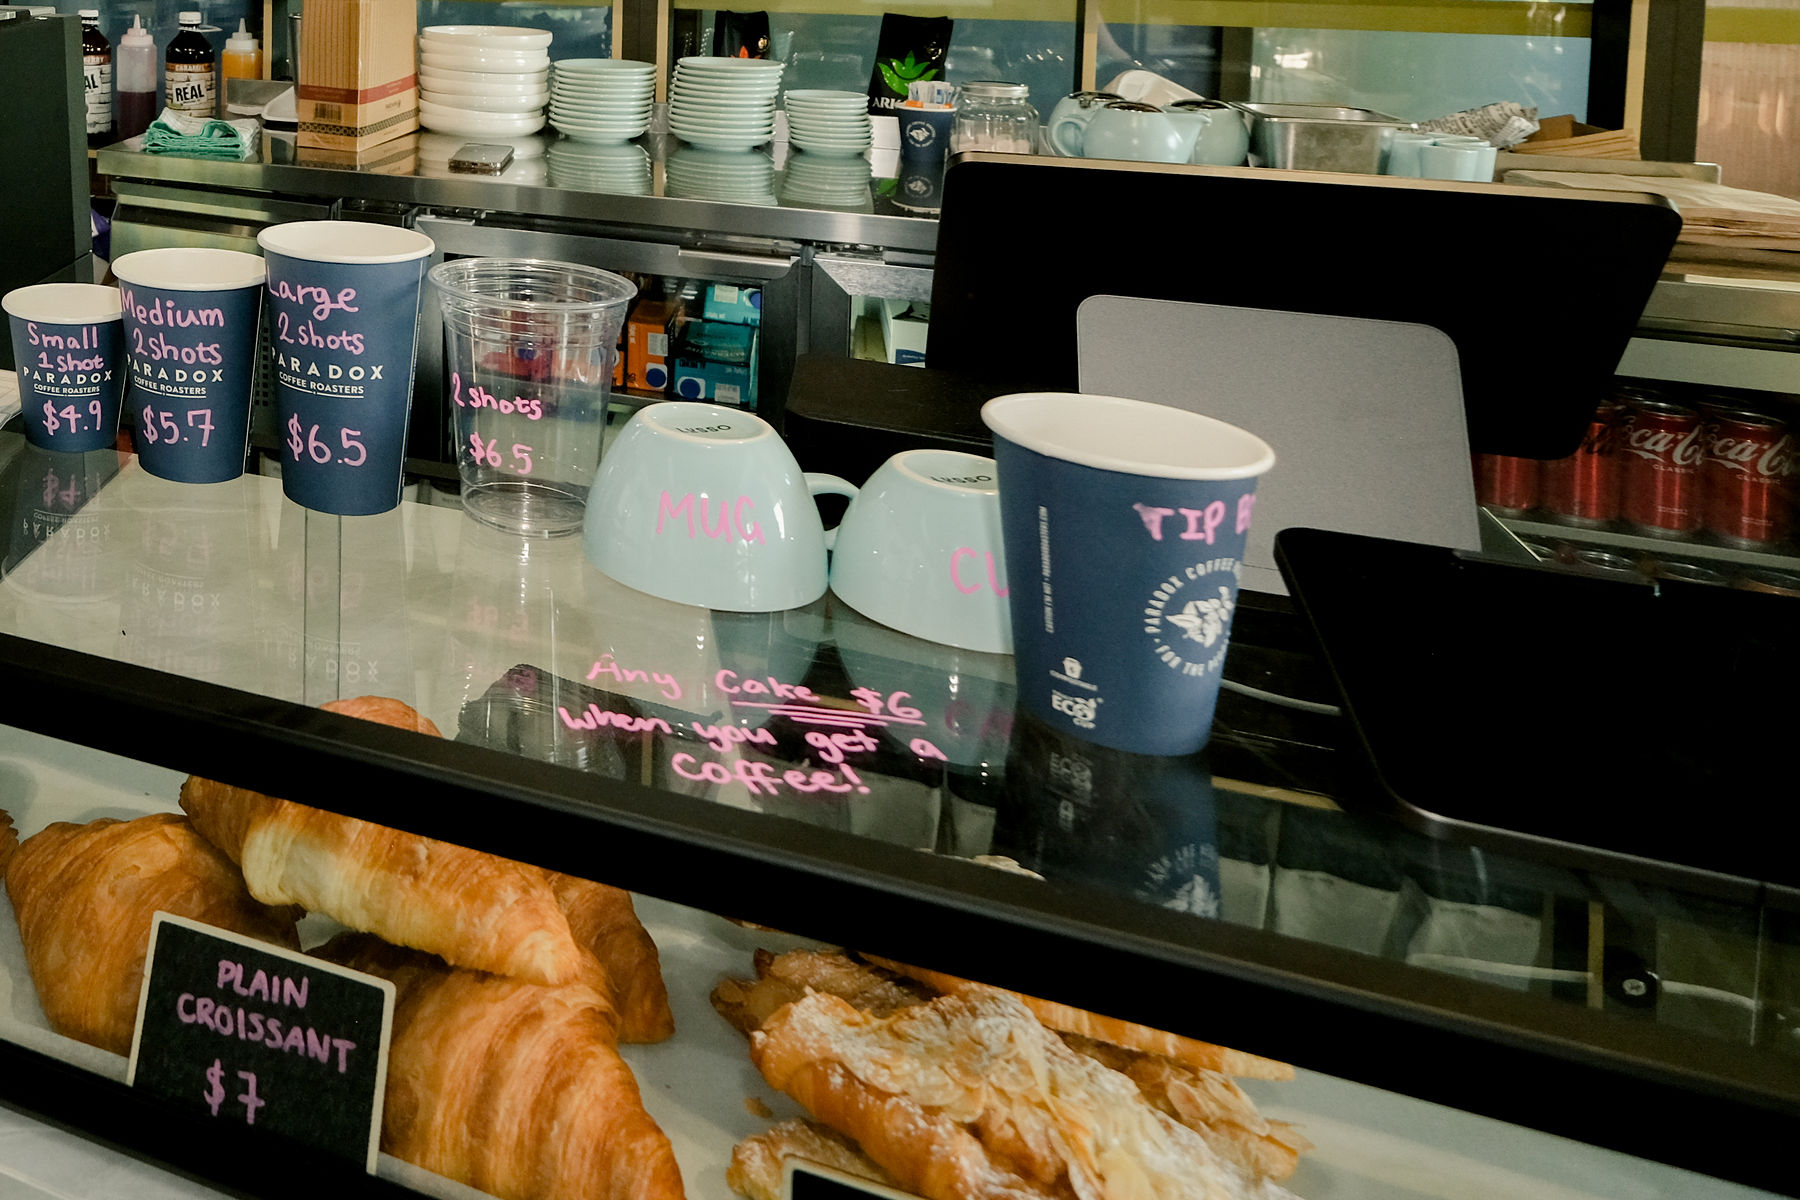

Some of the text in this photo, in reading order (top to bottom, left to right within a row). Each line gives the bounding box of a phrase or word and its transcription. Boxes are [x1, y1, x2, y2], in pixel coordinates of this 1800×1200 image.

[175, 84, 205, 102] REAL
[120, 291, 225, 329] Medium
[267, 278, 359, 321] Large
[27, 321, 99, 352] Small
[132, 327, 223, 367] 2 shots
[278, 311, 365, 355] 2 shots
[22, 367, 112, 384] PARADOX
[56, 347, 105, 373] shot
[126, 352, 224, 383] PARADOX
[271, 345, 384, 382] PARADOX
[33, 382, 100, 395] COFFEE ROASTERS
[134, 374, 208, 397] COFFEE ROASTERS
[278, 370, 365, 397] COFFEE ROASTERS
[451, 372, 542, 421] 2 shots
[42, 399, 103, 436] $4.9
[142, 404, 215, 448] $5.7
[287, 412, 368, 468] $6.5
[468, 430, 534, 475] $6.5
[1652, 463, 1695, 474] CLASSIC
[1736, 473, 1781, 485] CLASSIC
[656, 490, 766, 545] MUG
[1132, 501, 1226, 545] TIP
[949, 547, 1010, 598] CU
[1144, 557, 1235, 634] PARADOX COFFEE
[1155, 645, 1205, 677] FOR THE
[586, 655, 923, 720] Any Cake $6
[692, 718, 778, 753] you
[805, 725, 880, 764] get
[908, 737, 948, 762] a
[216, 958, 310, 1009] PLAIN
[176, 990, 356, 1074] CROISSANT
[203, 1058, 266, 1124] $7
